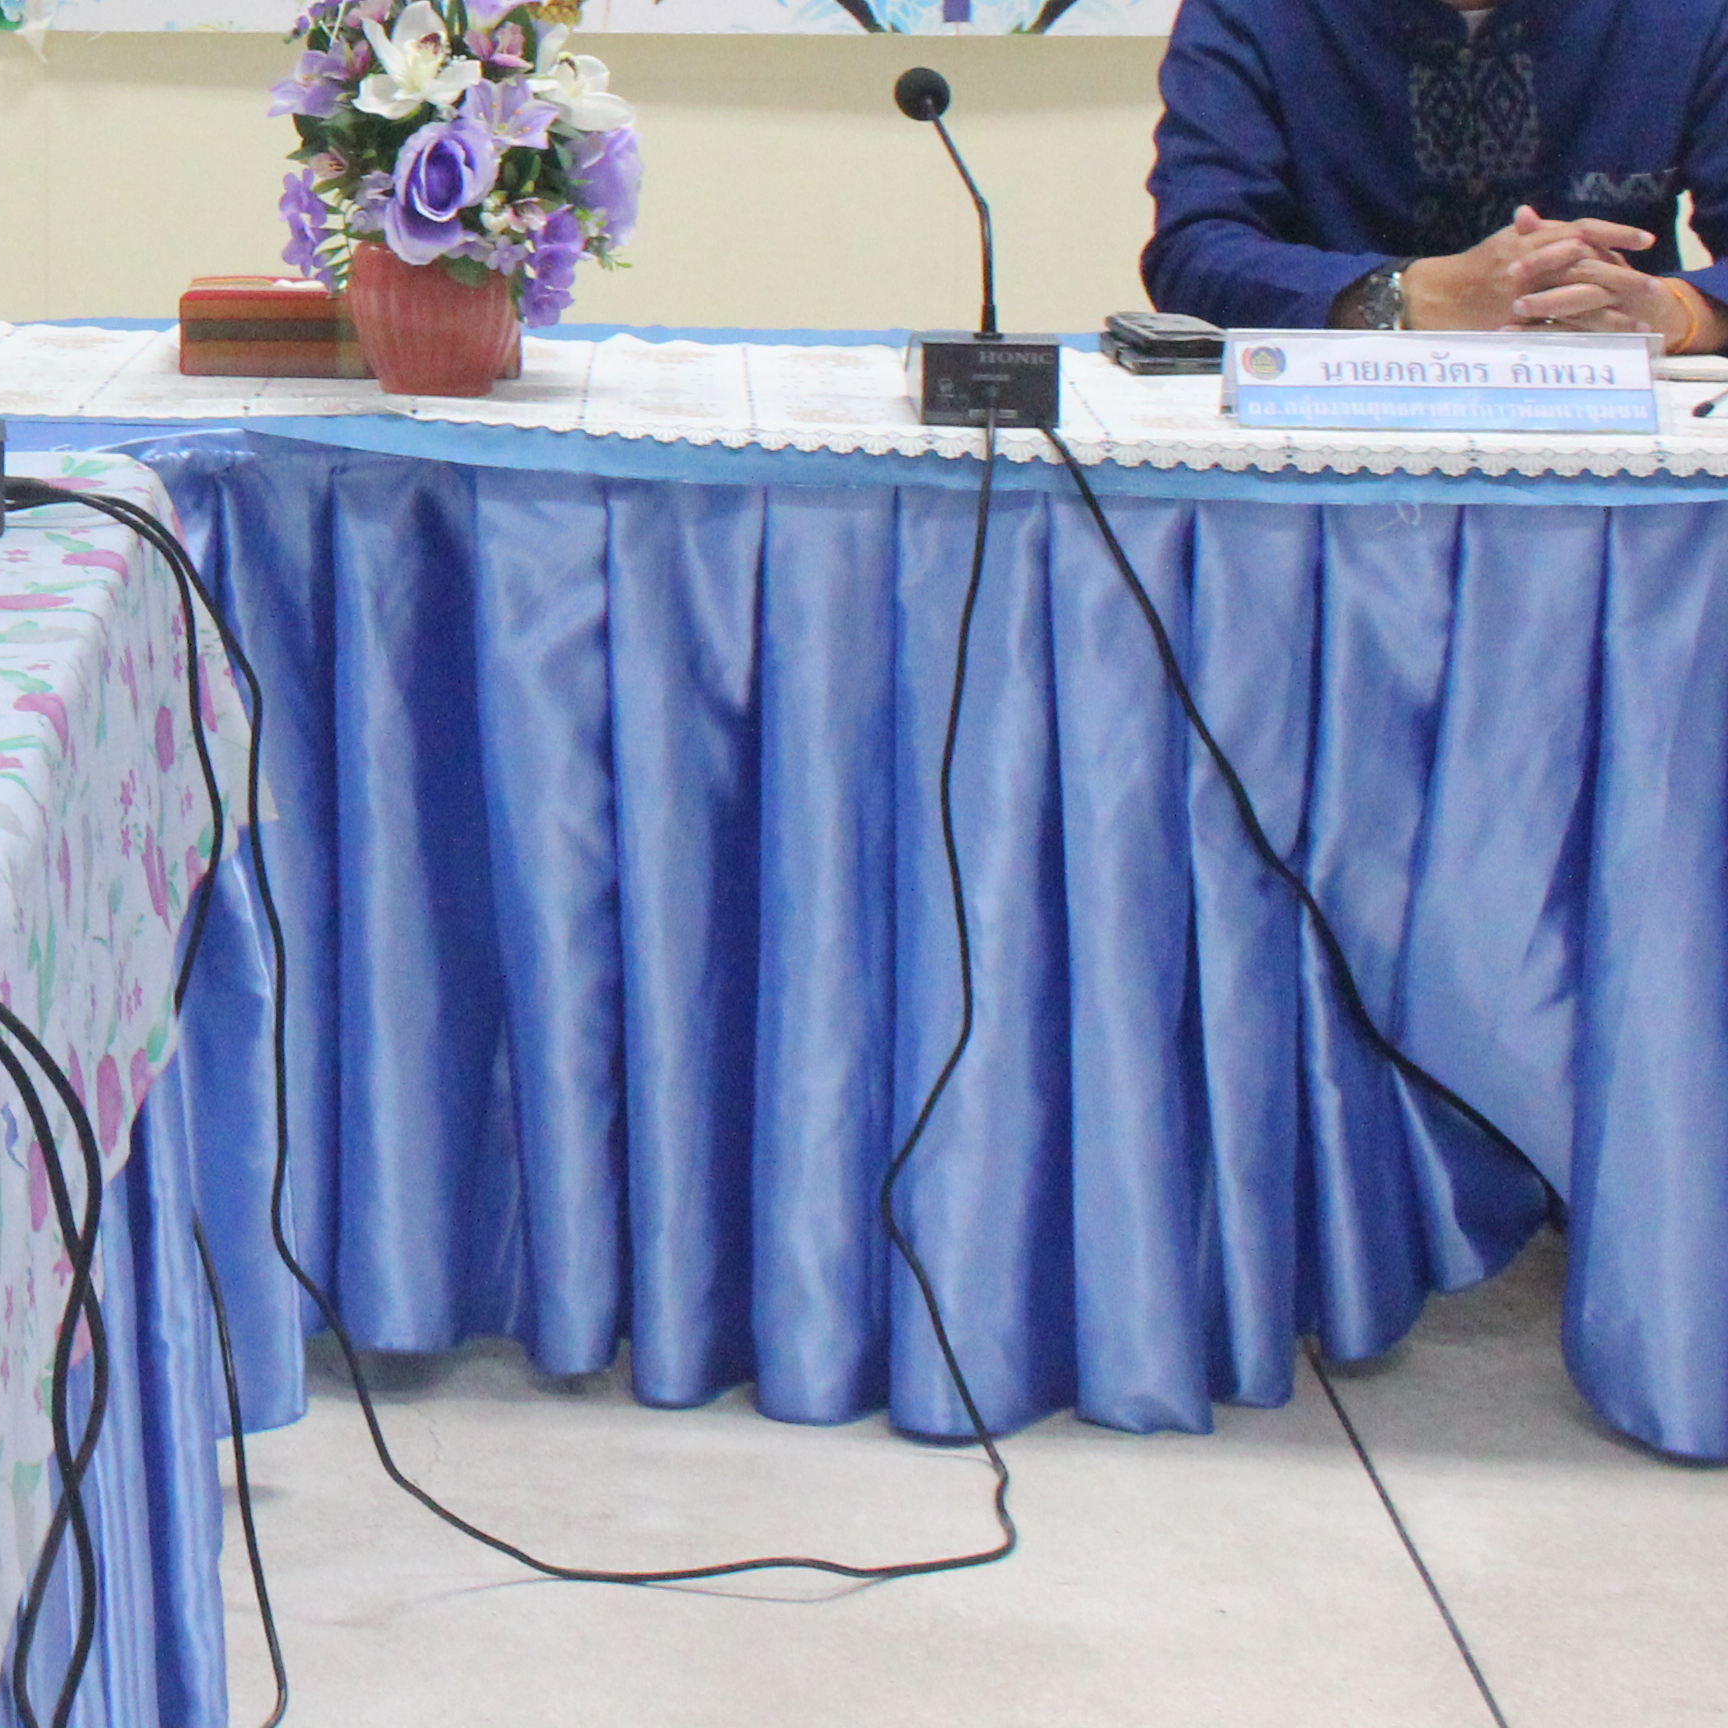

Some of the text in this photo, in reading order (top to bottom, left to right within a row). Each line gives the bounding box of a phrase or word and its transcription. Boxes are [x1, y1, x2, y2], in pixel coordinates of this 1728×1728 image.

[978, 350, 1055, 365] HONIC
[1320, 351, 1616, 385] นายภควัตร คำพวง
